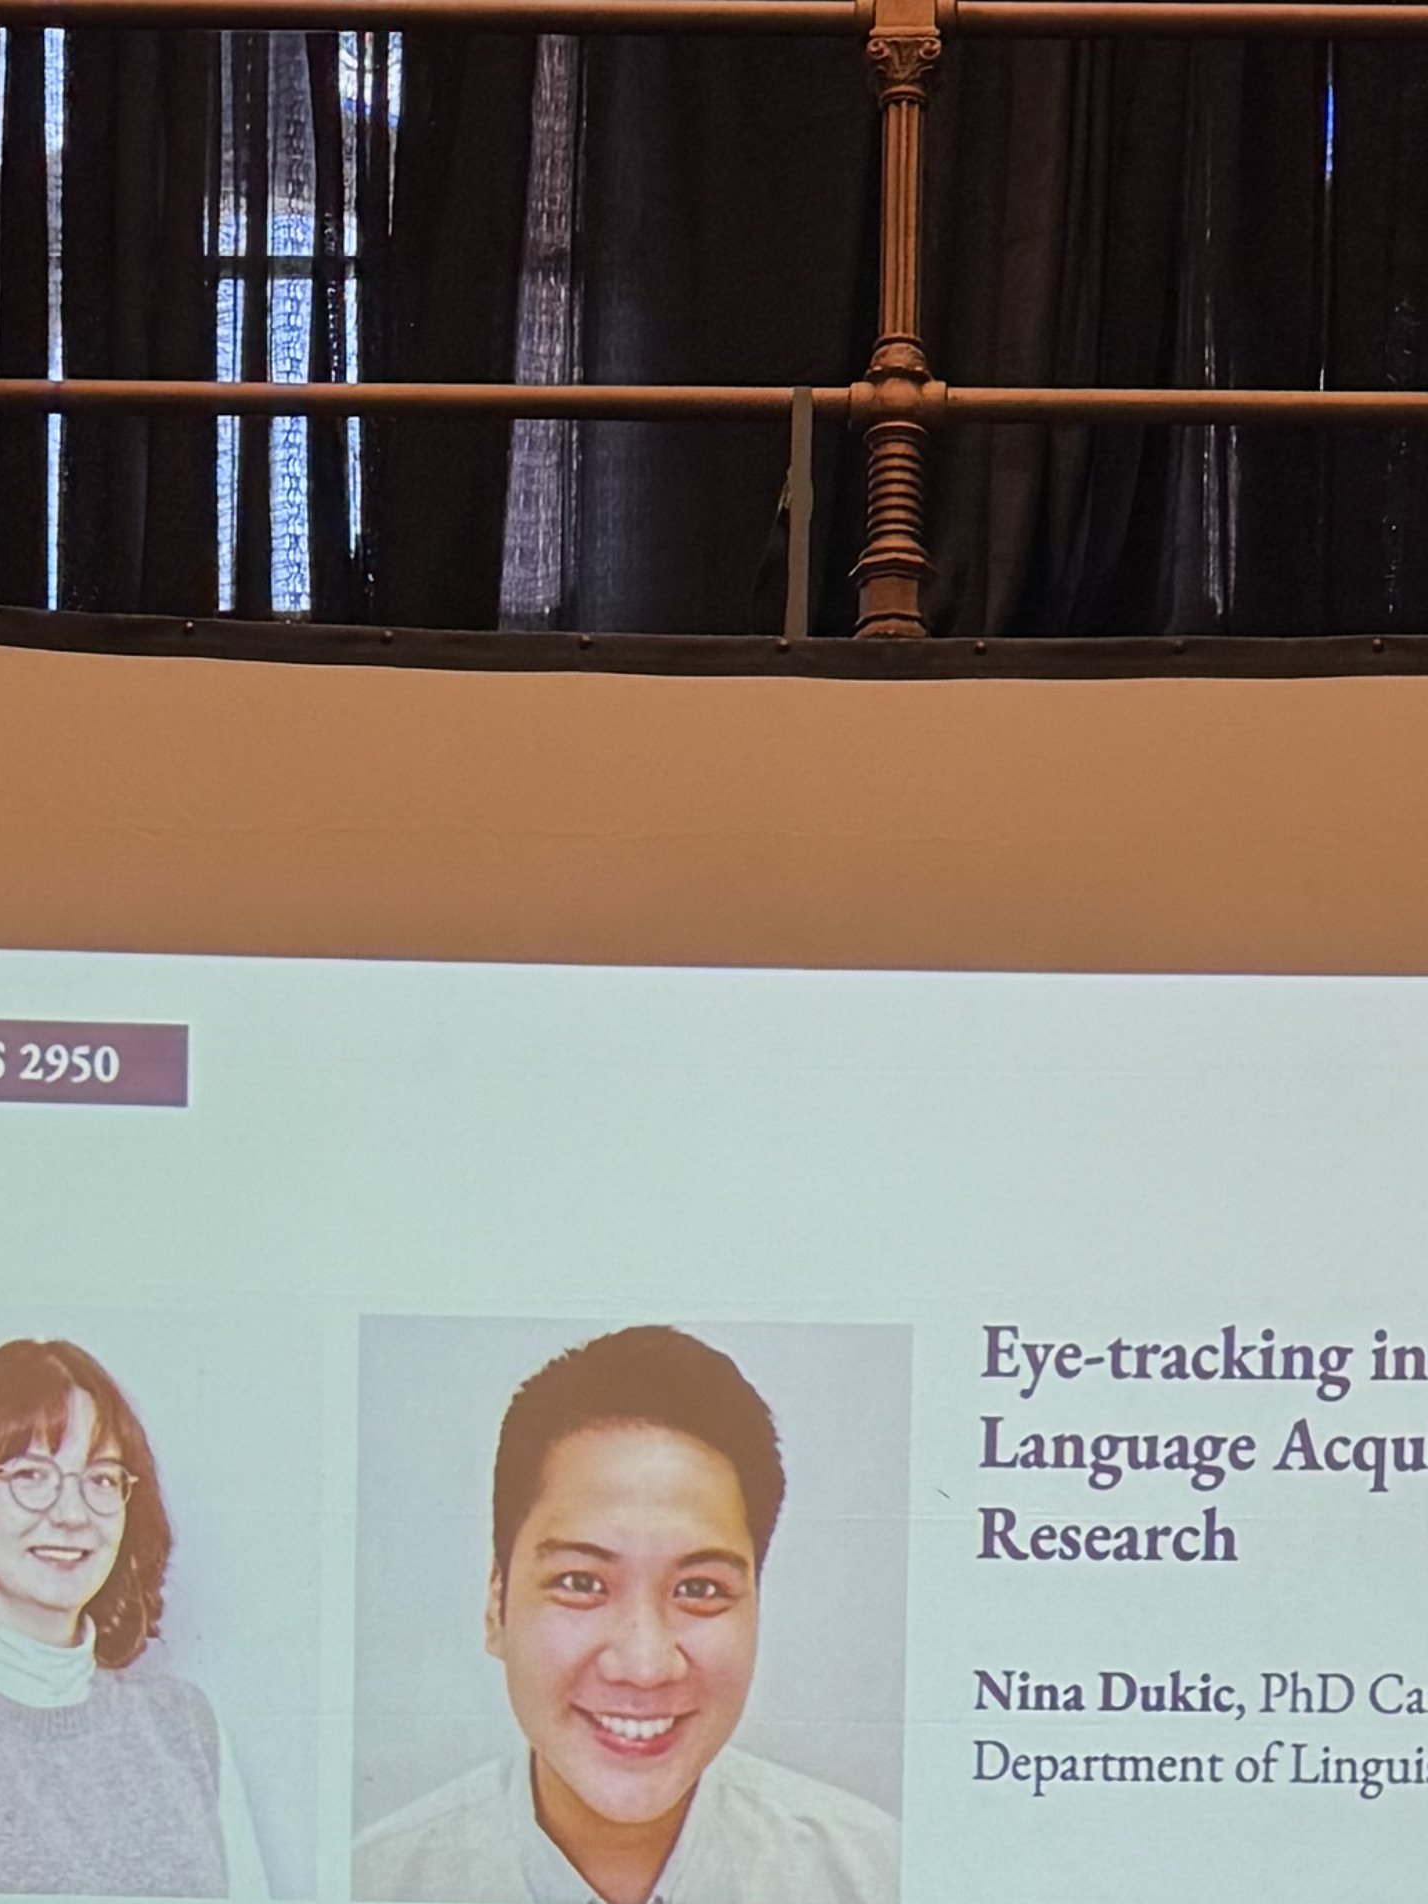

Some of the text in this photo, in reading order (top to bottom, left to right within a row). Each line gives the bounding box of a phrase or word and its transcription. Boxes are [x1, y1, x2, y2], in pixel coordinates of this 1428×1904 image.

[19, 1043, 119, 1083] 2950
[981, 1325, 1354, 1402] Eye-tracking
[1370, 1329, 1428, 1380] in
[979, 1416, 1256, 1492] Language
[976, 1506, 1238, 1561] Research
[973, 1670, 1085, 1711] Nina
[1097, 1670, 1245, 1721] Dukic,
[1259, 1671, 1355, 1713] PhD
[972, 1740, 1224, 1797] Department
[1235, 1740, 1285, 1783] of
